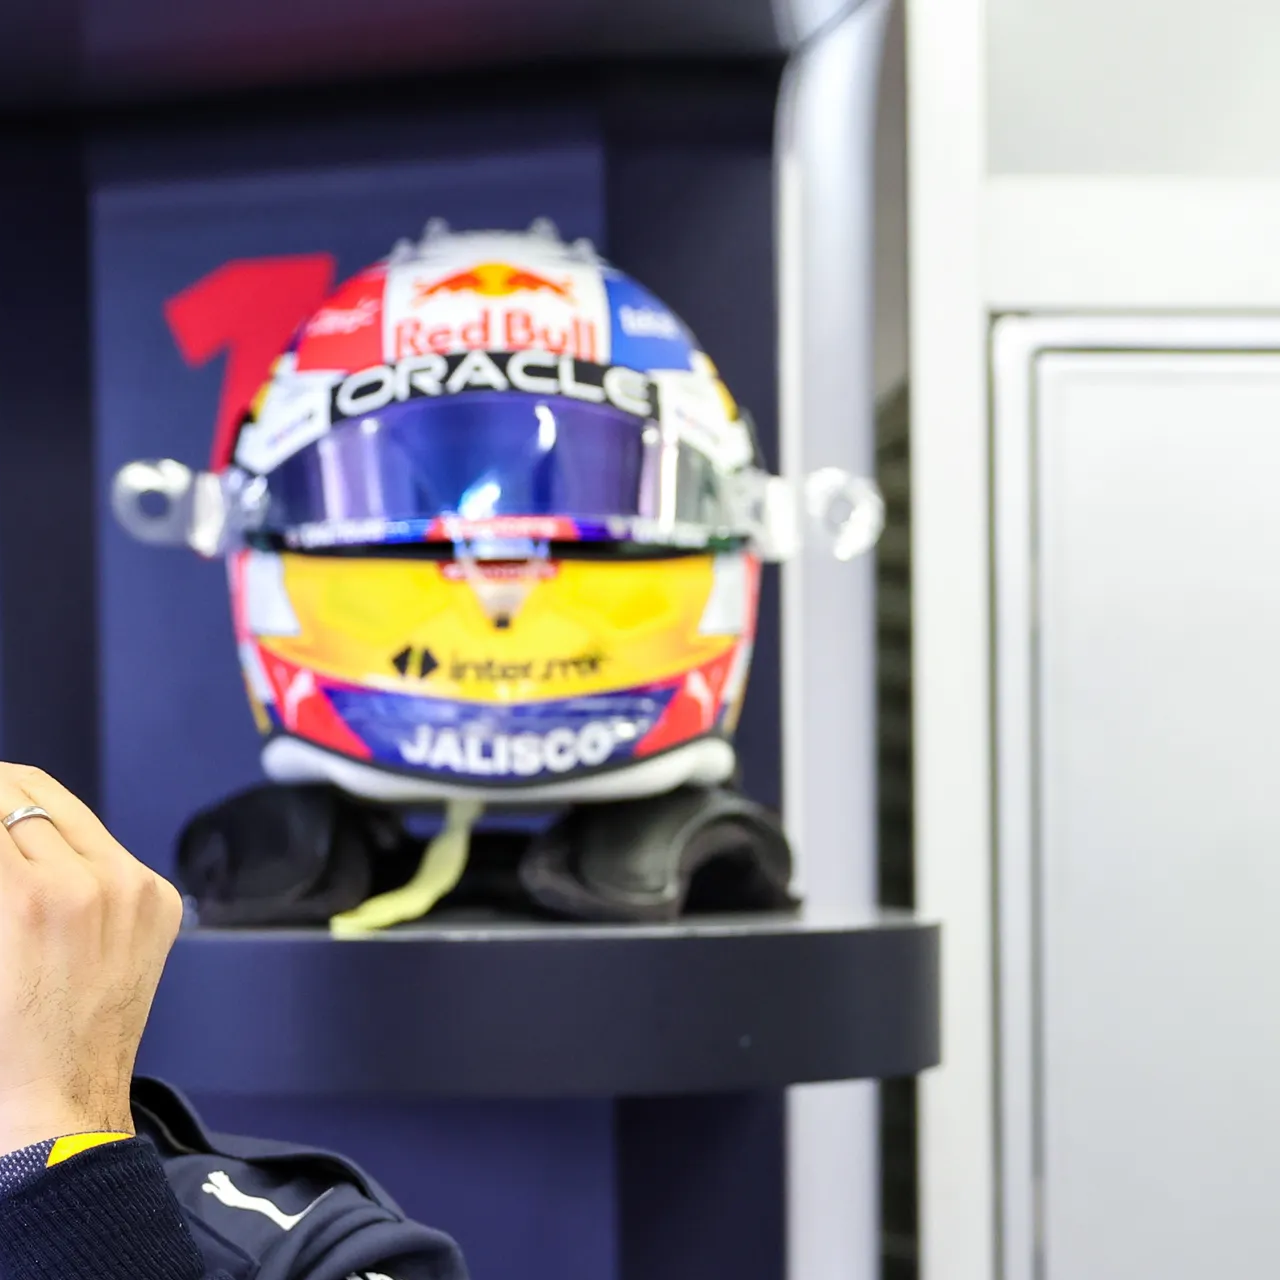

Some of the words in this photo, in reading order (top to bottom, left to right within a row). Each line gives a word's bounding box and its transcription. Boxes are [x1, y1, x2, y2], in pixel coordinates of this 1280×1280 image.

[394, 309, 490, 361] Red
[505, 311, 597, 362] Bull
[336, 352, 652, 416] ORACLE
[400, 720, 616, 776] JALISCO
